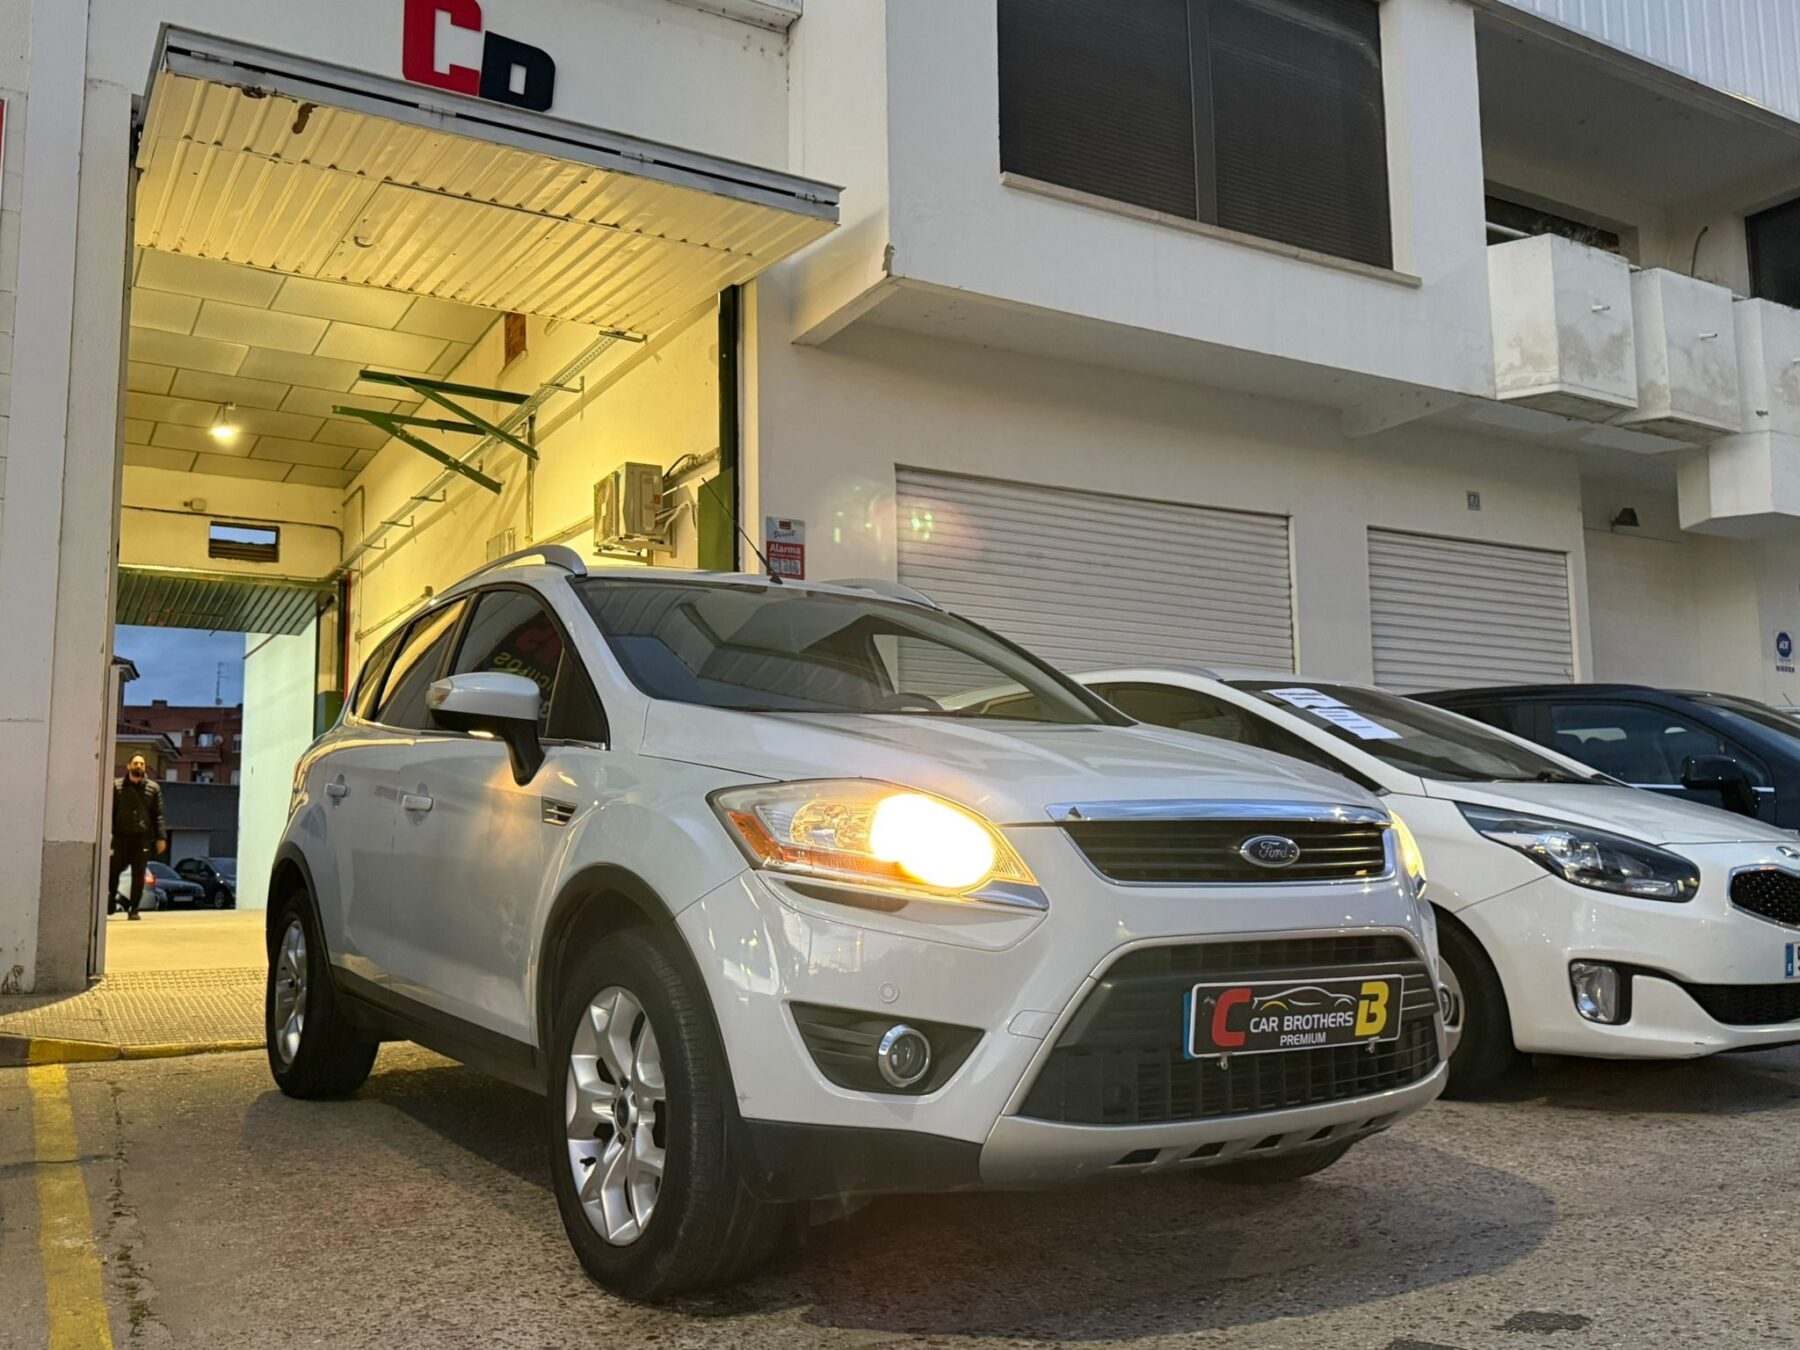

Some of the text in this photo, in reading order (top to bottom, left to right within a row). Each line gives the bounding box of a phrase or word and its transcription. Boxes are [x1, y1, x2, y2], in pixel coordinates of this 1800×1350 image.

[770, 543, 801, 554] Alarma
[1258, 841, 1288, 859] Ford
[1212, 988, 1251, 1047] C
[1250, 1017, 1278, 1033] CAR
[1283, 1011, 1354, 1032] BROTHERS
[1280, 1032, 1326, 1046] PREMIUM
